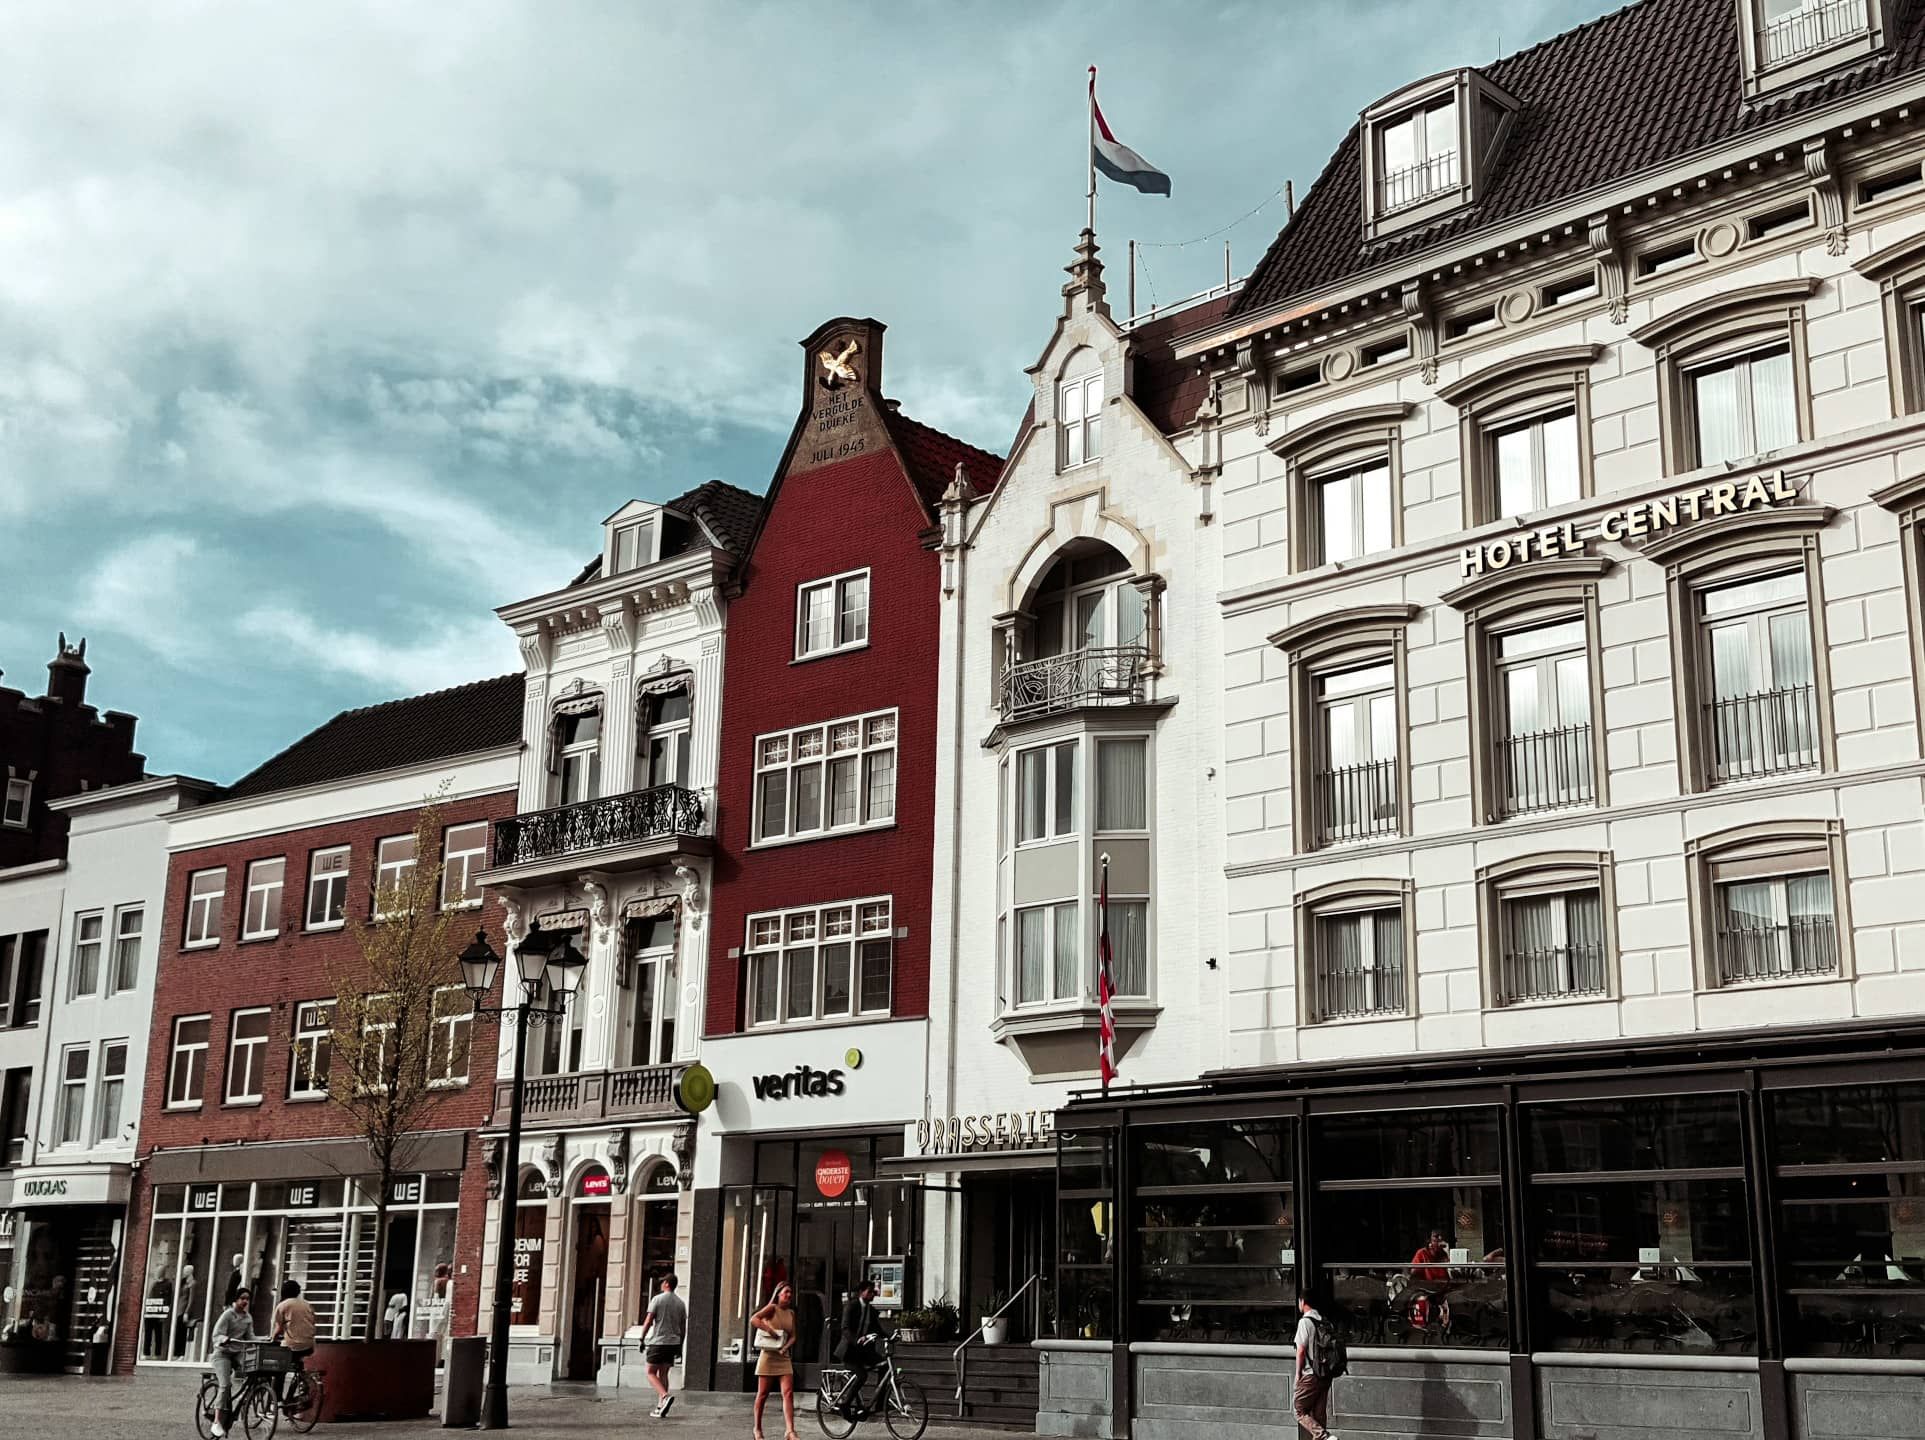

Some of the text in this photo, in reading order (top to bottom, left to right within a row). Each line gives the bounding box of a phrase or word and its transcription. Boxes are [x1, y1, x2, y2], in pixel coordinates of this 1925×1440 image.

[812, 396, 865, 421] VERGULDE
[829, 391, 849, 406] HET
[819, 412, 857, 433] DUIFKE
[810, 438, 865, 464] JULI 1945
[1460, 469, 1798, 578] HOTEL CENTRAL
[322, 855, 343, 871] WE
[752, 1065, 846, 1101] veritas
[917, 1111, 1051, 1151] BRASSERIE
[194, 1191, 217, 1209] WE
[290, 1187, 314, 1205] WE
[393, 1182, 419, 1200] WE
